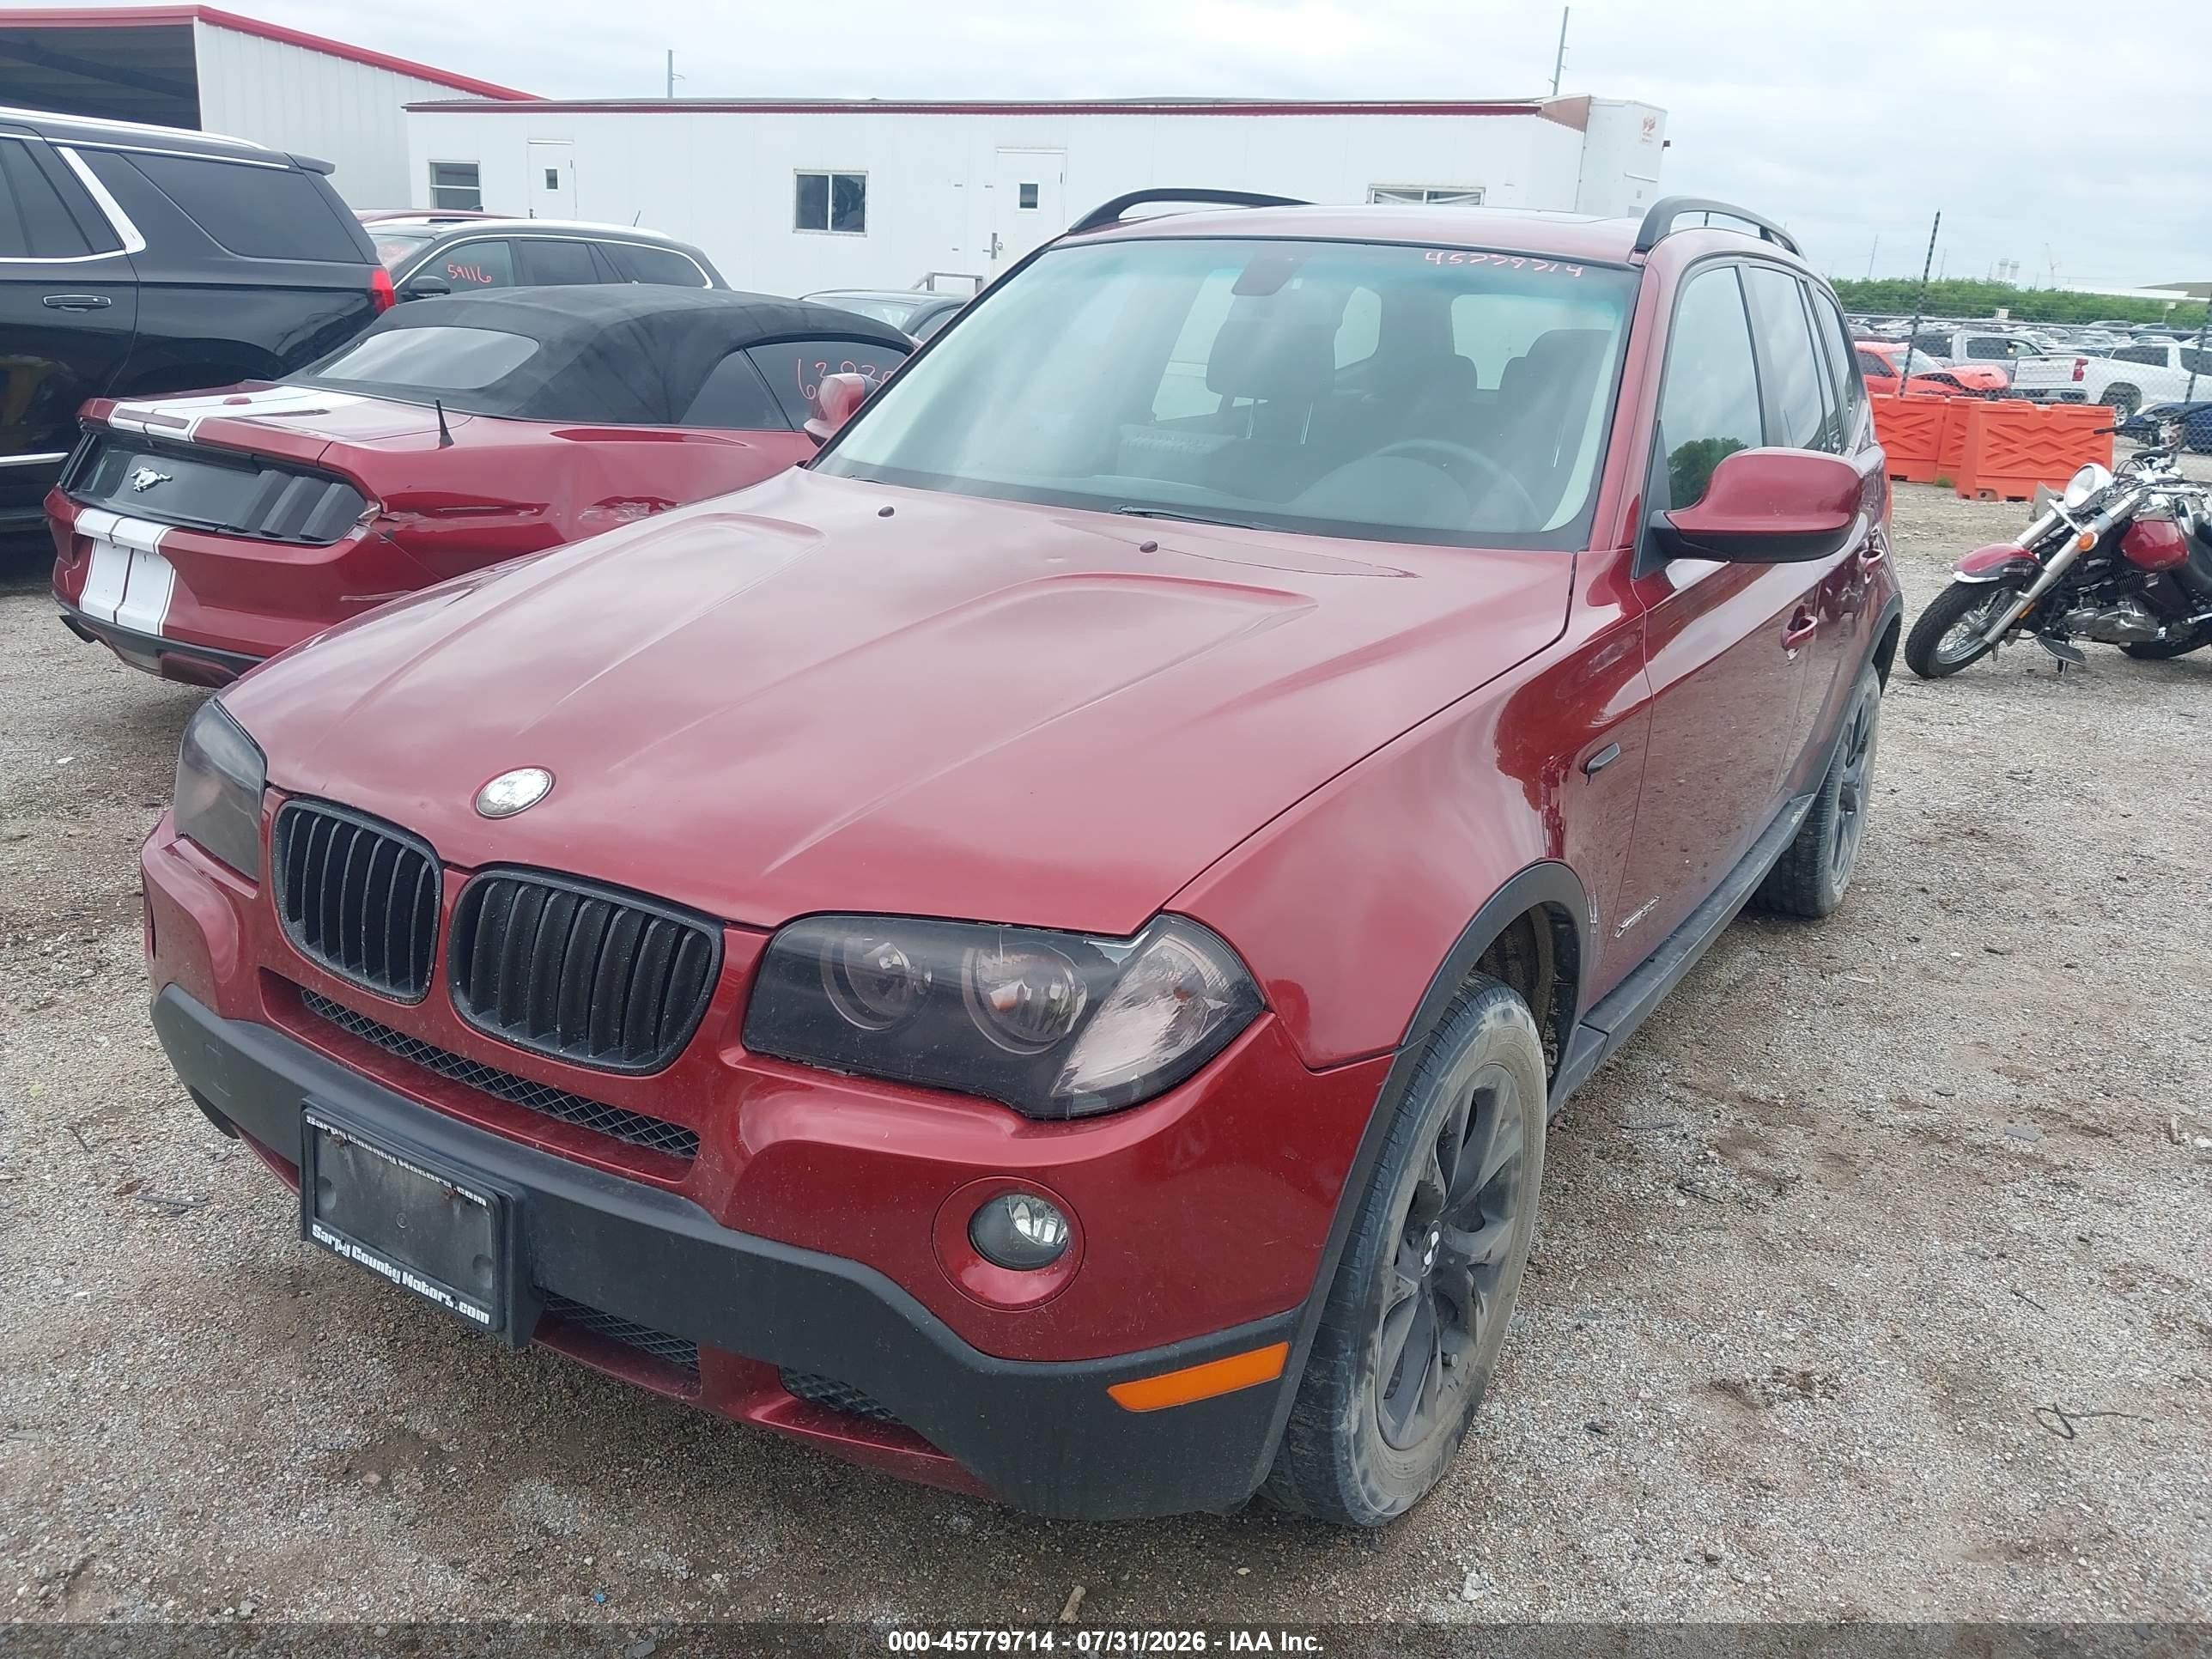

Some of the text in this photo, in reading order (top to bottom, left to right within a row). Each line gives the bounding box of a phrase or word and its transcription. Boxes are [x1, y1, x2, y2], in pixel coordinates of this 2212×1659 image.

[447, 264, 492, 283] 59116
[312, 1223, 490, 1325] Sarpy County Motors.com
